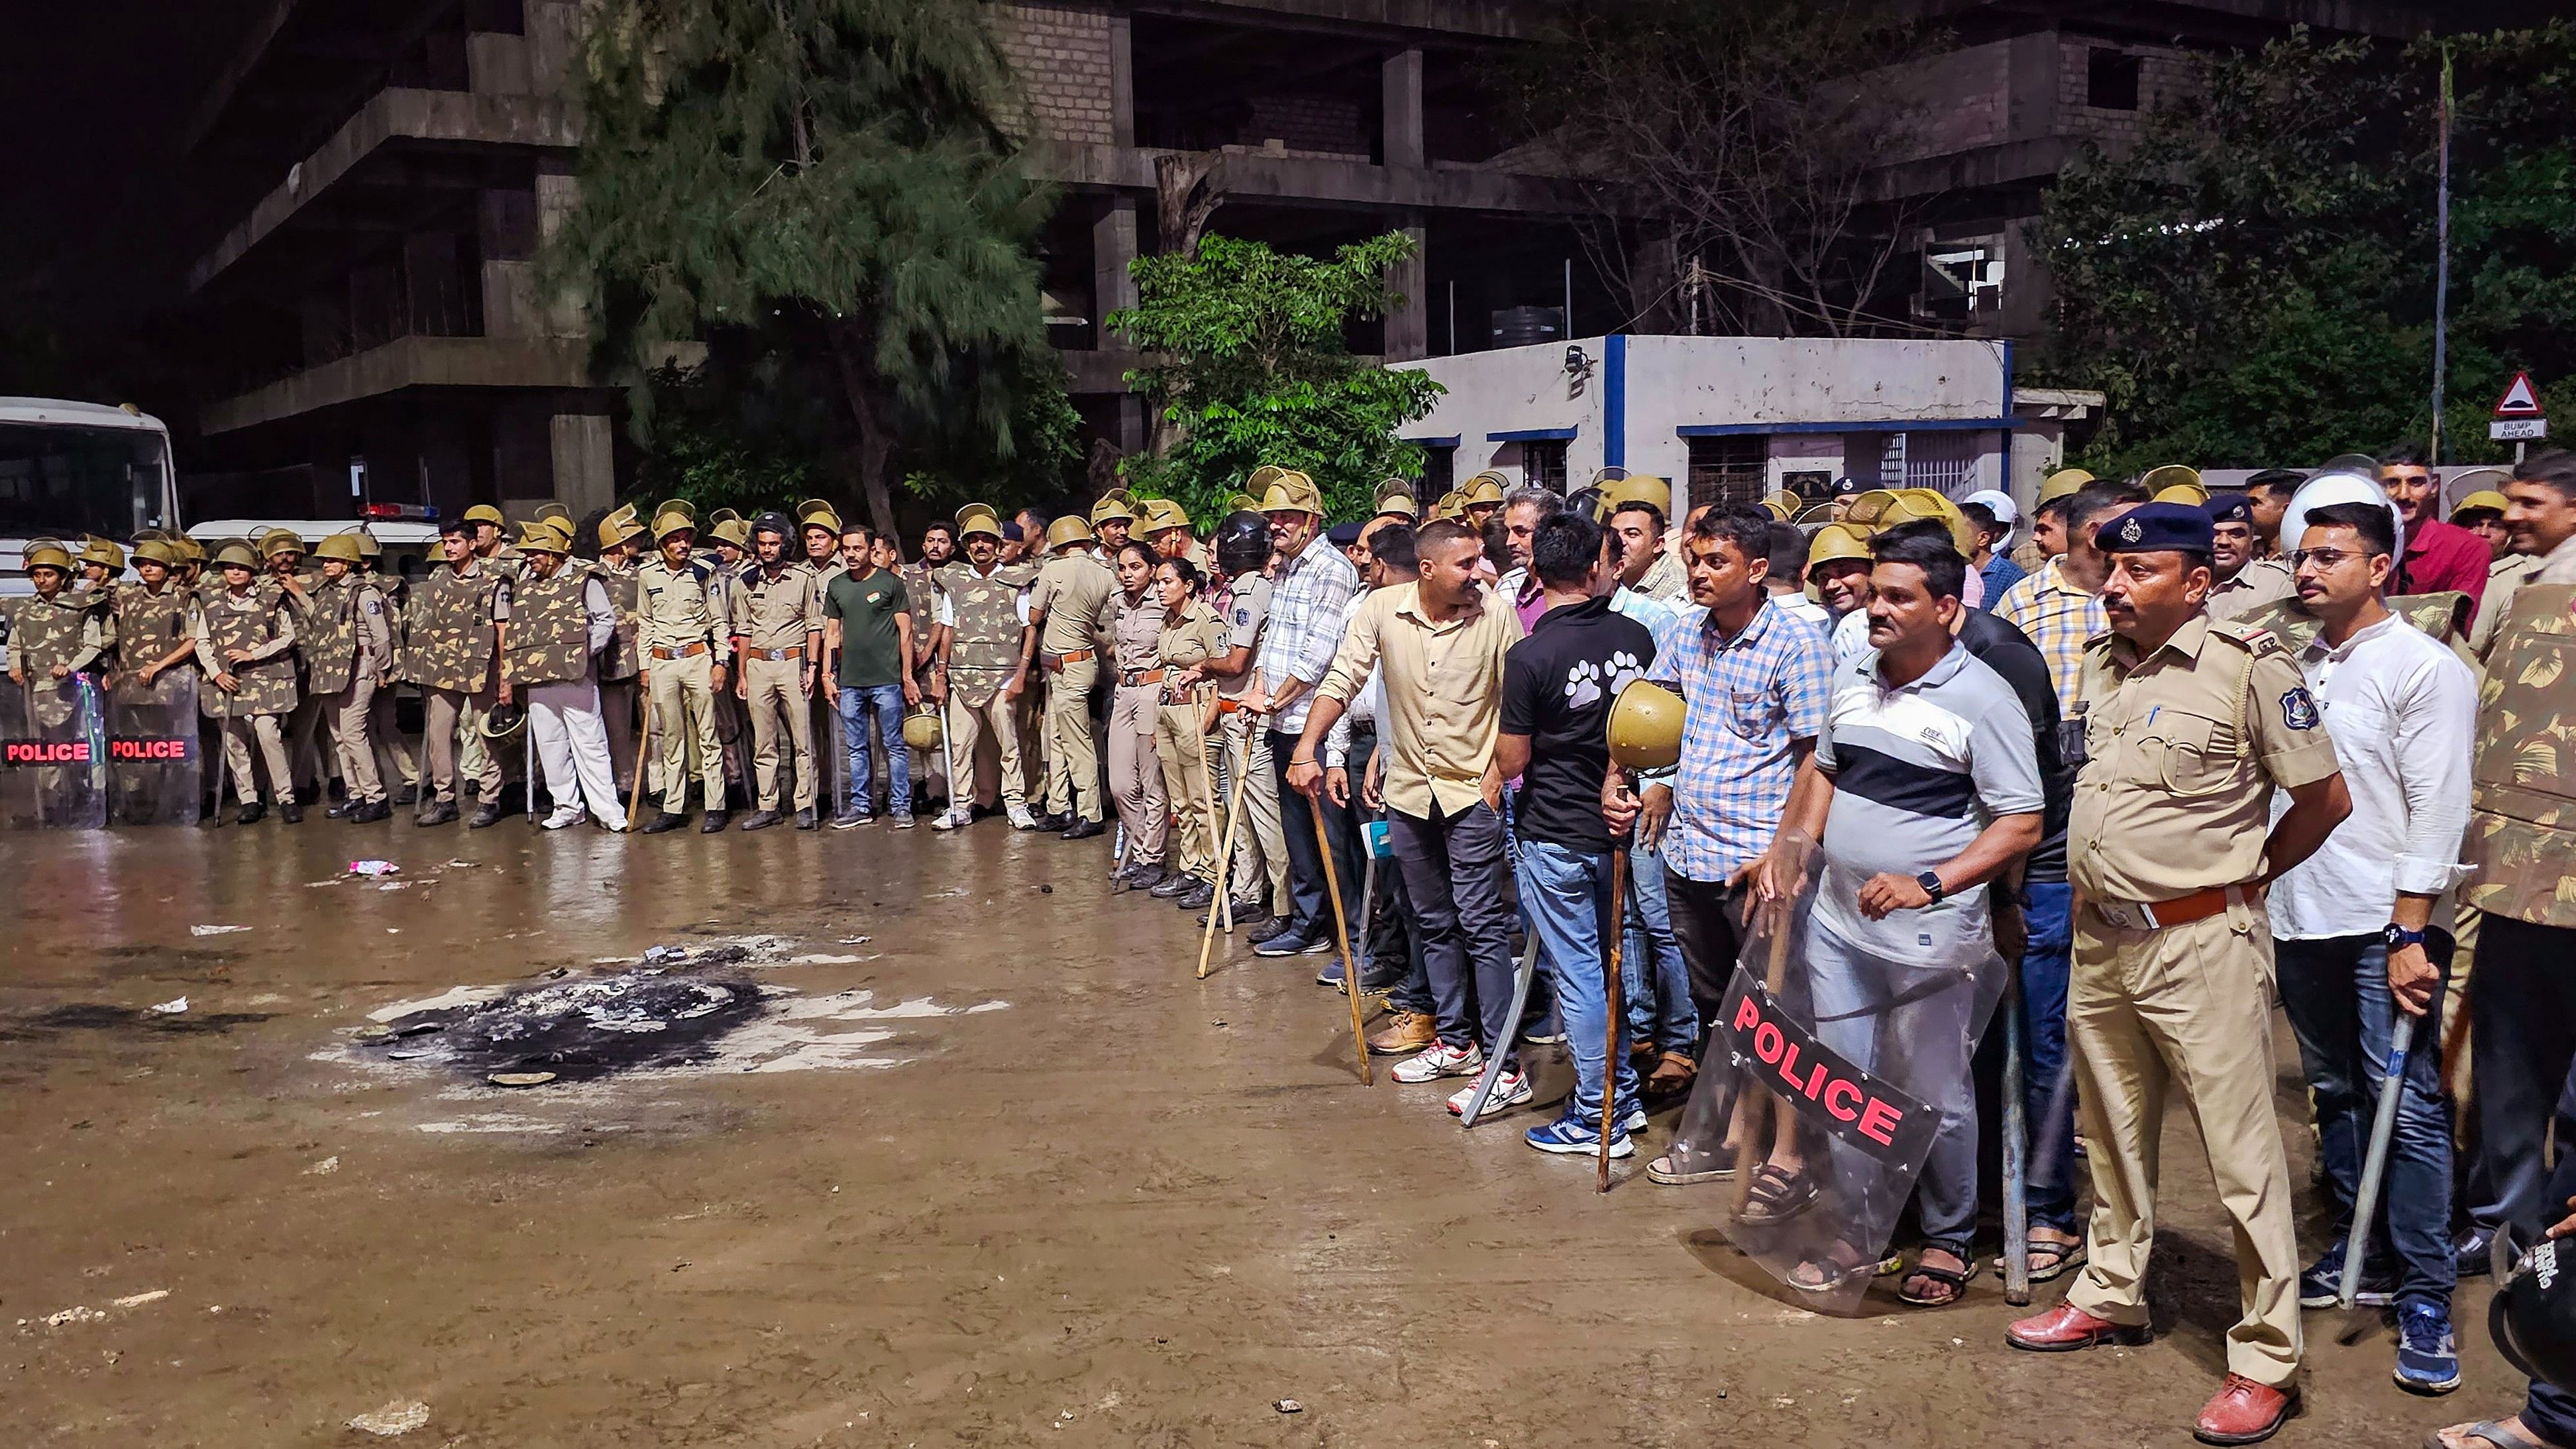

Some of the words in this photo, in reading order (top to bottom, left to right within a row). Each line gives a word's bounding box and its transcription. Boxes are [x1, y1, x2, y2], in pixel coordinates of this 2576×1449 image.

[7, 743, 89, 761] POLICE
[112, 741, 185, 758] POLICE
[1734, 994, 1904, 1147] POLICE
